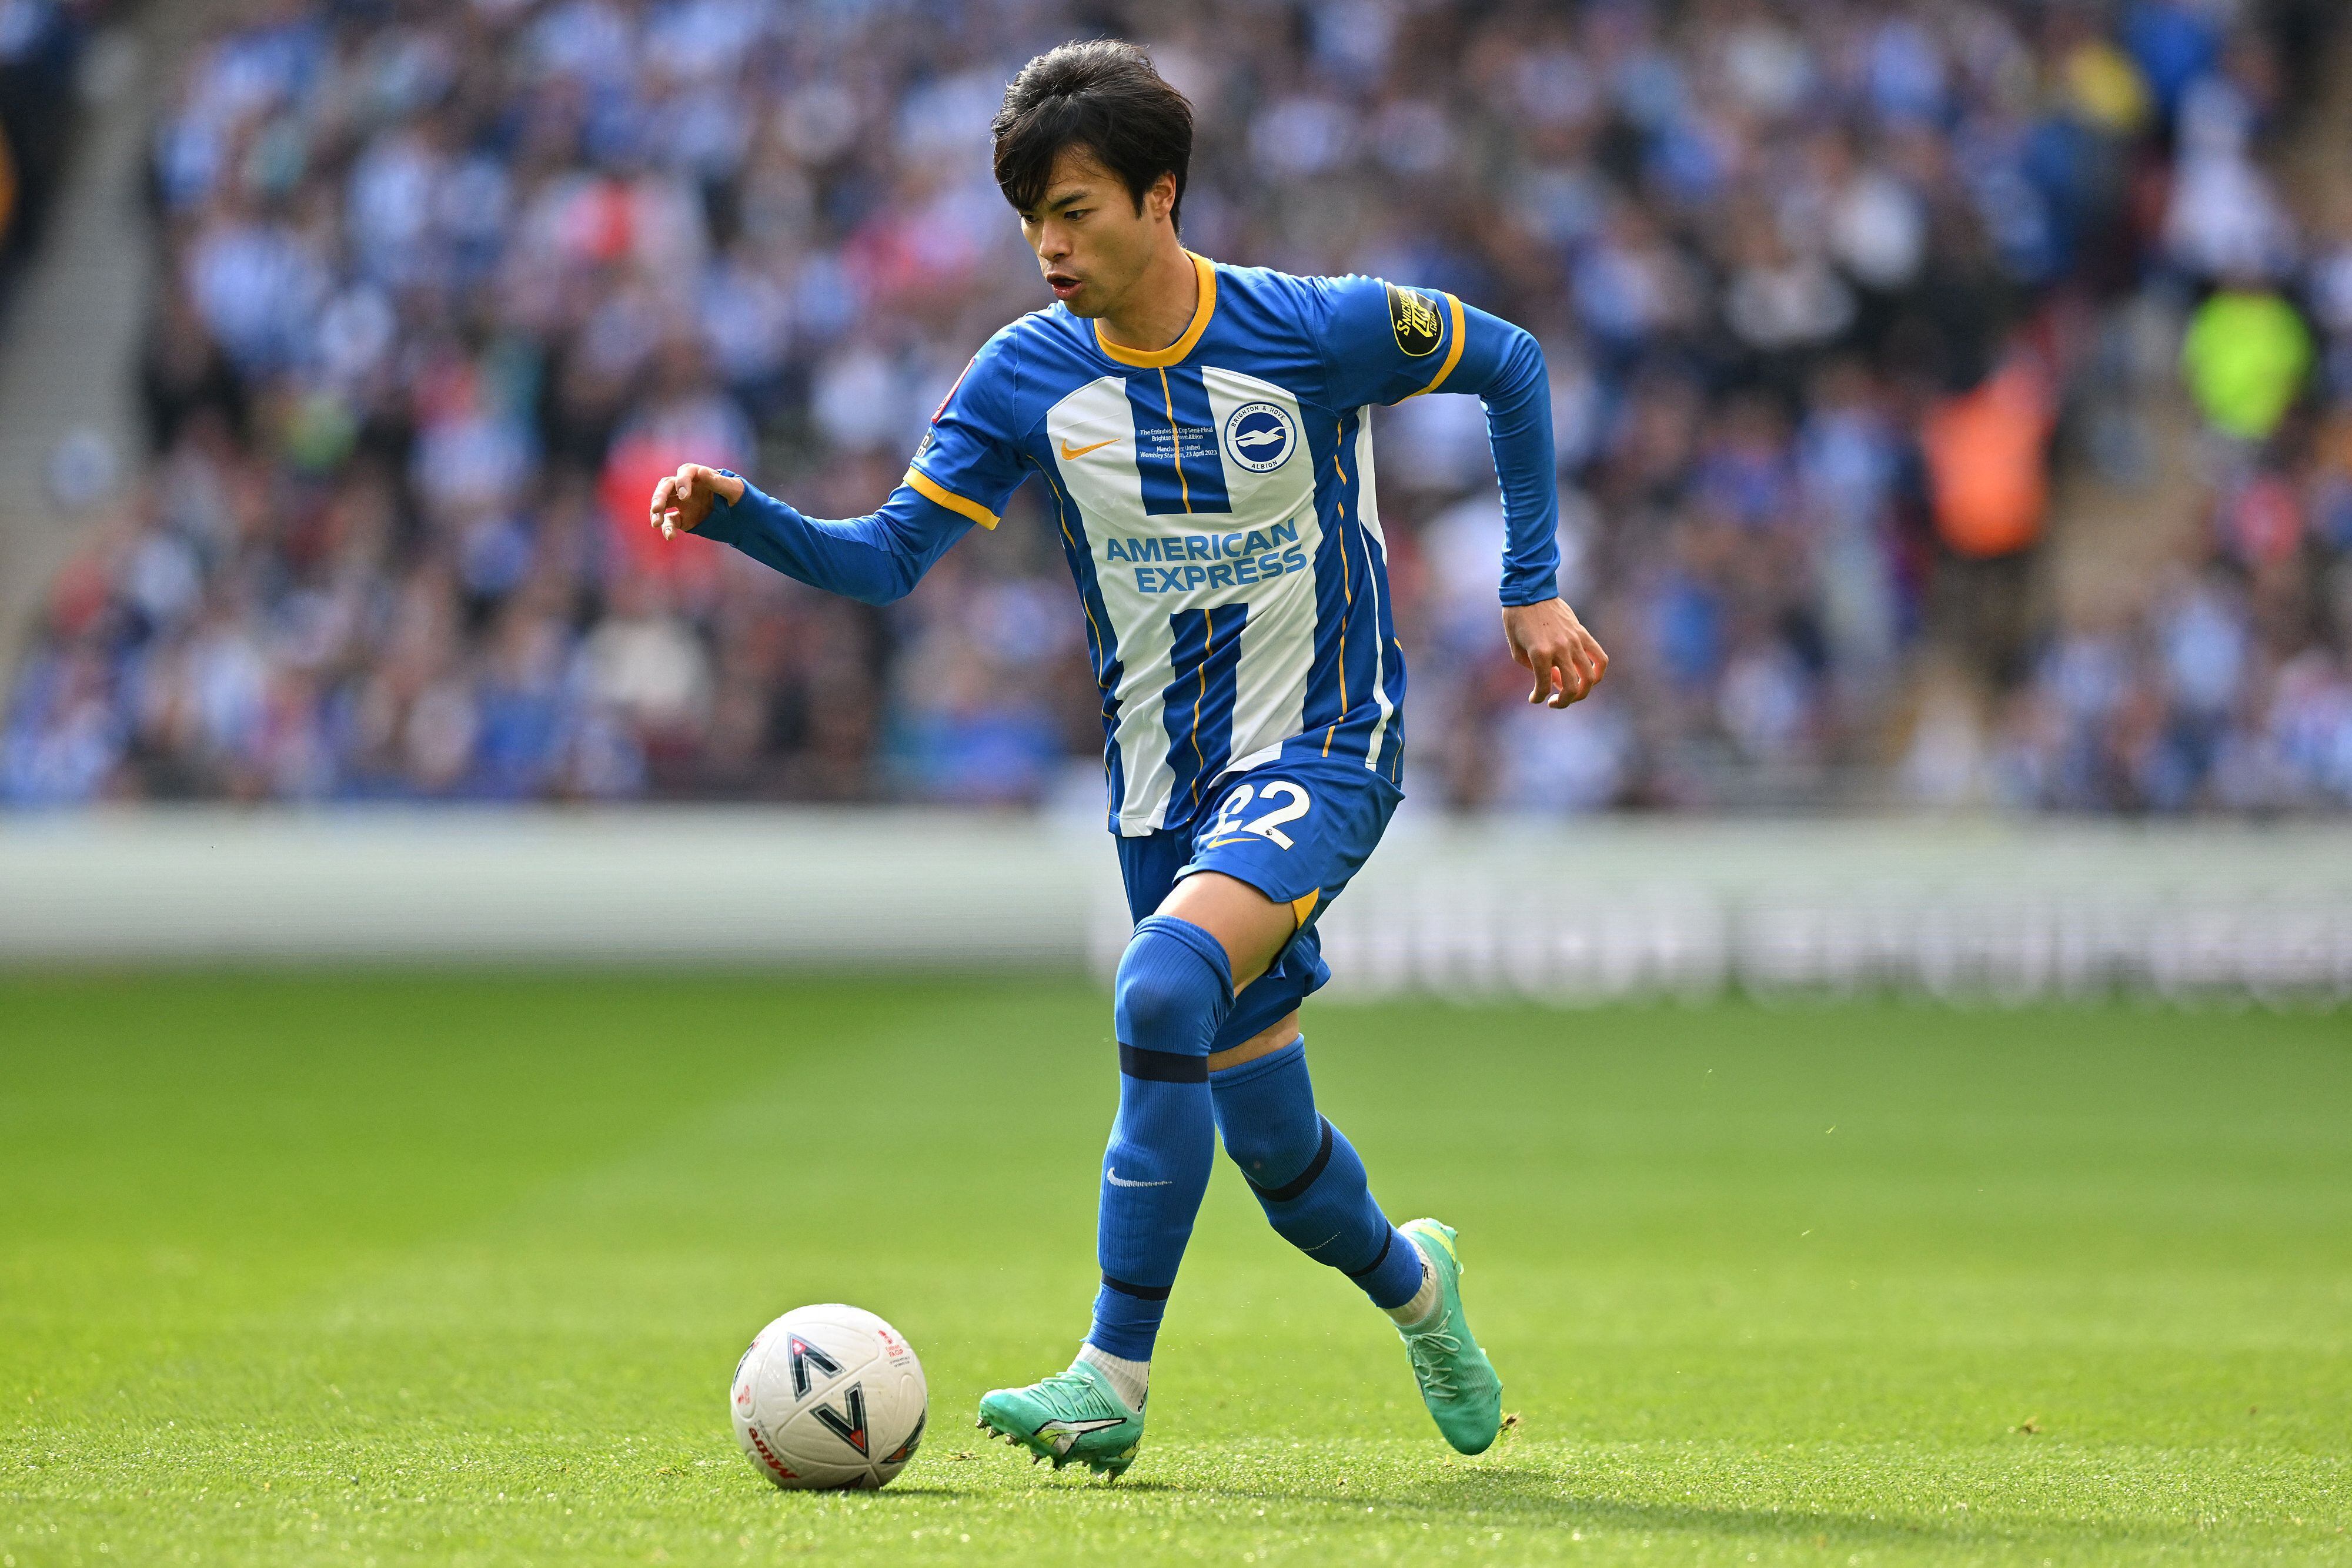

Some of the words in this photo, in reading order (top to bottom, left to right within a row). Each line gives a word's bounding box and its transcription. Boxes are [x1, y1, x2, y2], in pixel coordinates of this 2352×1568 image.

[1396, 287, 1412, 336] SNICKE
[1231, 406, 1259, 427] BRIGHTON
[1270, 407, 1285, 420] HOVE
[1140, 451, 1164, 459] Wembley
[1251, 460, 1278, 469] ALBION
[1107, 517, 1299, 562] AMERICAN
[1134, 544, 1307, 593] EXPRESS
[1198, 780, 1311, 851] 22
